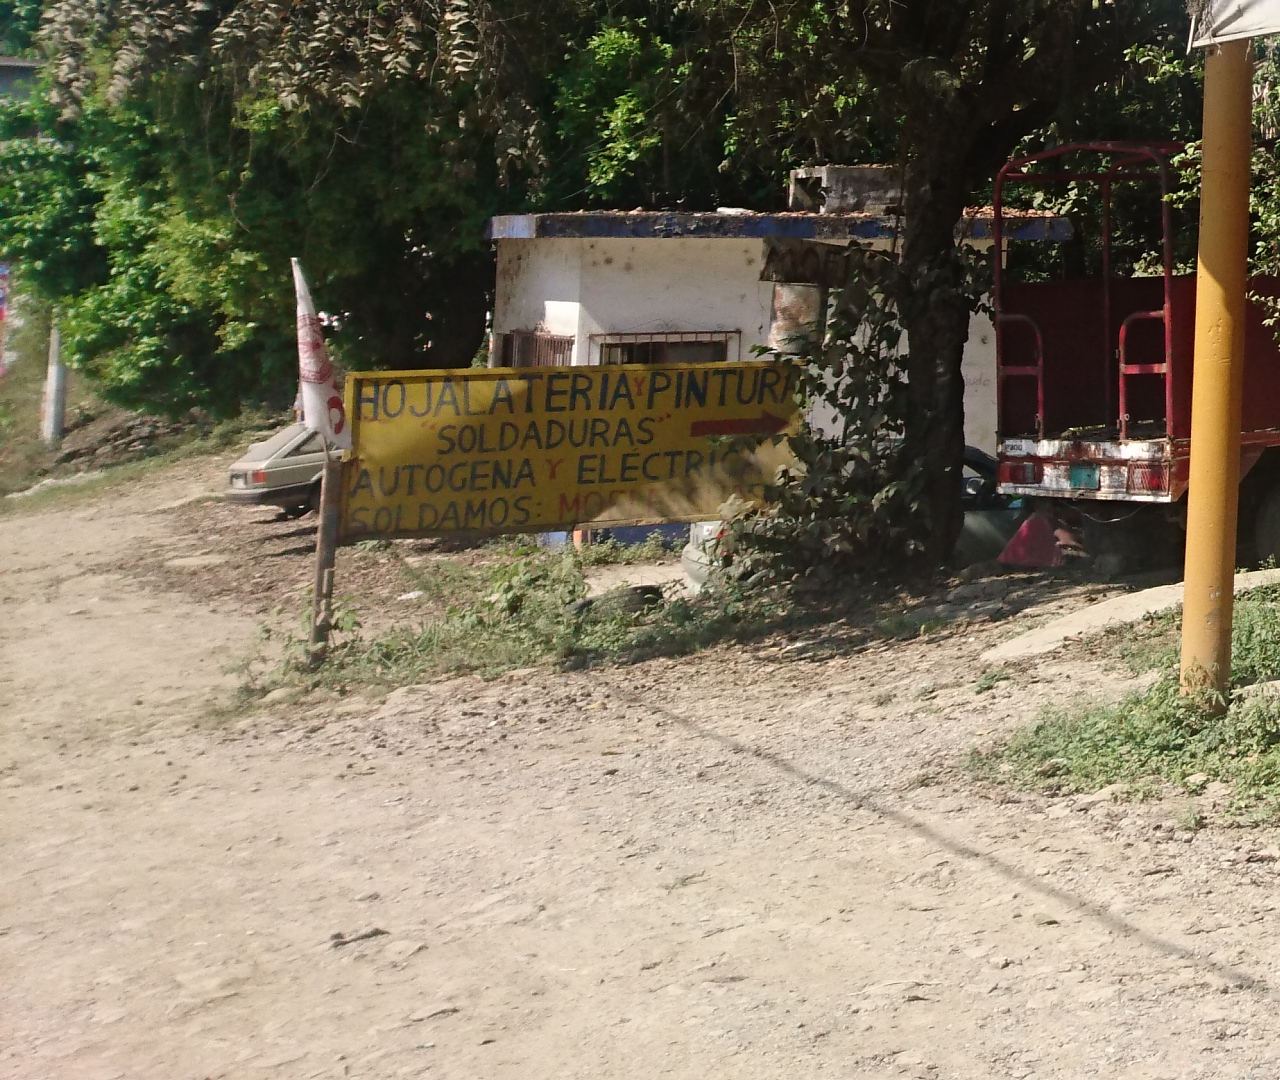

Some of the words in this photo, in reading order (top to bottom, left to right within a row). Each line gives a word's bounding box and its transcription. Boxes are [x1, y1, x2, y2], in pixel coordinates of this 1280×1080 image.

[358, 370, 635, 421] HOJALATERIA
[633, 376, 645, 397] Y
[545, 459, 565, 480] Y
